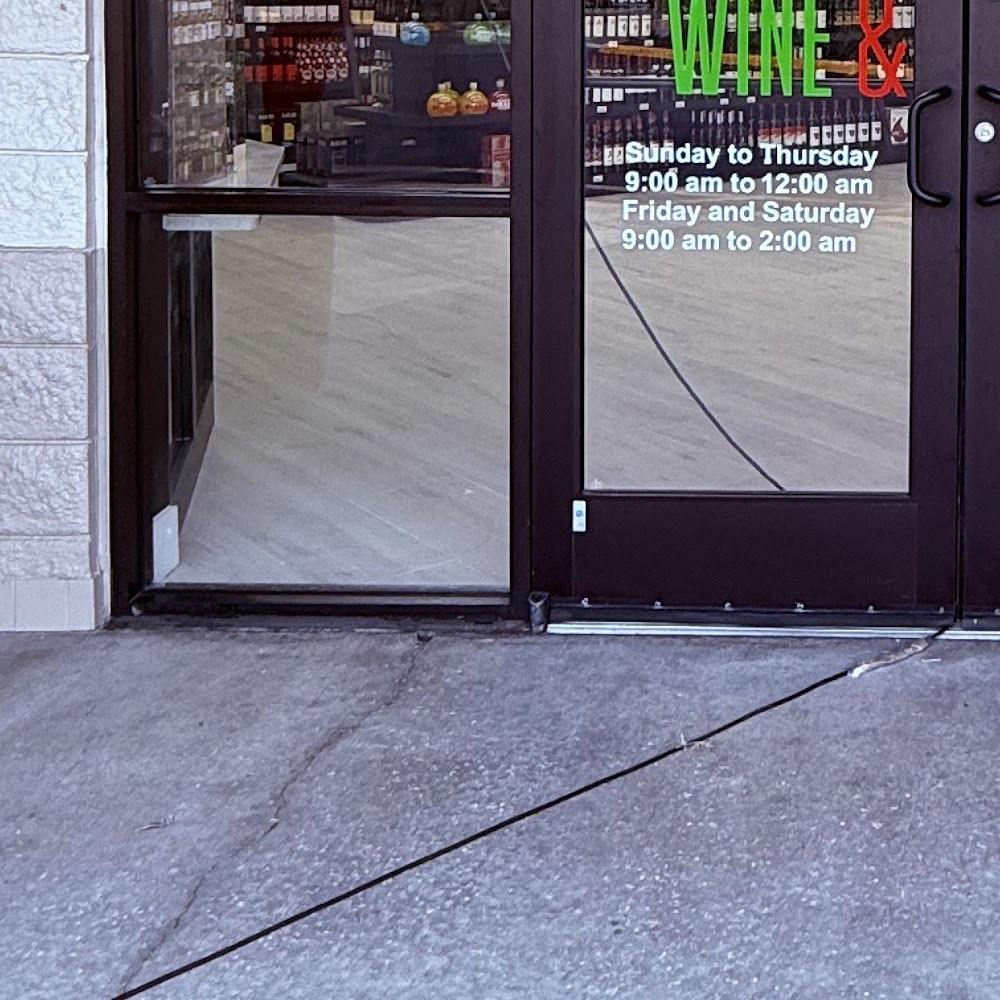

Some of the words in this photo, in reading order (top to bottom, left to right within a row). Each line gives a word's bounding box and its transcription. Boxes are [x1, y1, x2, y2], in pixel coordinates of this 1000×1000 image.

[625, 141, 721, 169] Sunday
[727, 144, 753, 165] to
[760, 143, 879, 172] Thursday
[625, 171, 678, 193] 9:00
[685, 176, 723, 193] am
[730, 173, 756, 194] to
[761, 173, 828, 194] 12:00
[834, 178, 873, 195] am
[622, 200, 702, 227] Friday
[707, 201, 755, 222] and
[761, 201, 876, 229] Saturday
[621, 228, 675, 250] 9:00
[681, 234, 720, 251] am
[726, 230, 752, 251] to
[759, 230, 811, 252] 2:00
[818, 235, 856, 253] am
